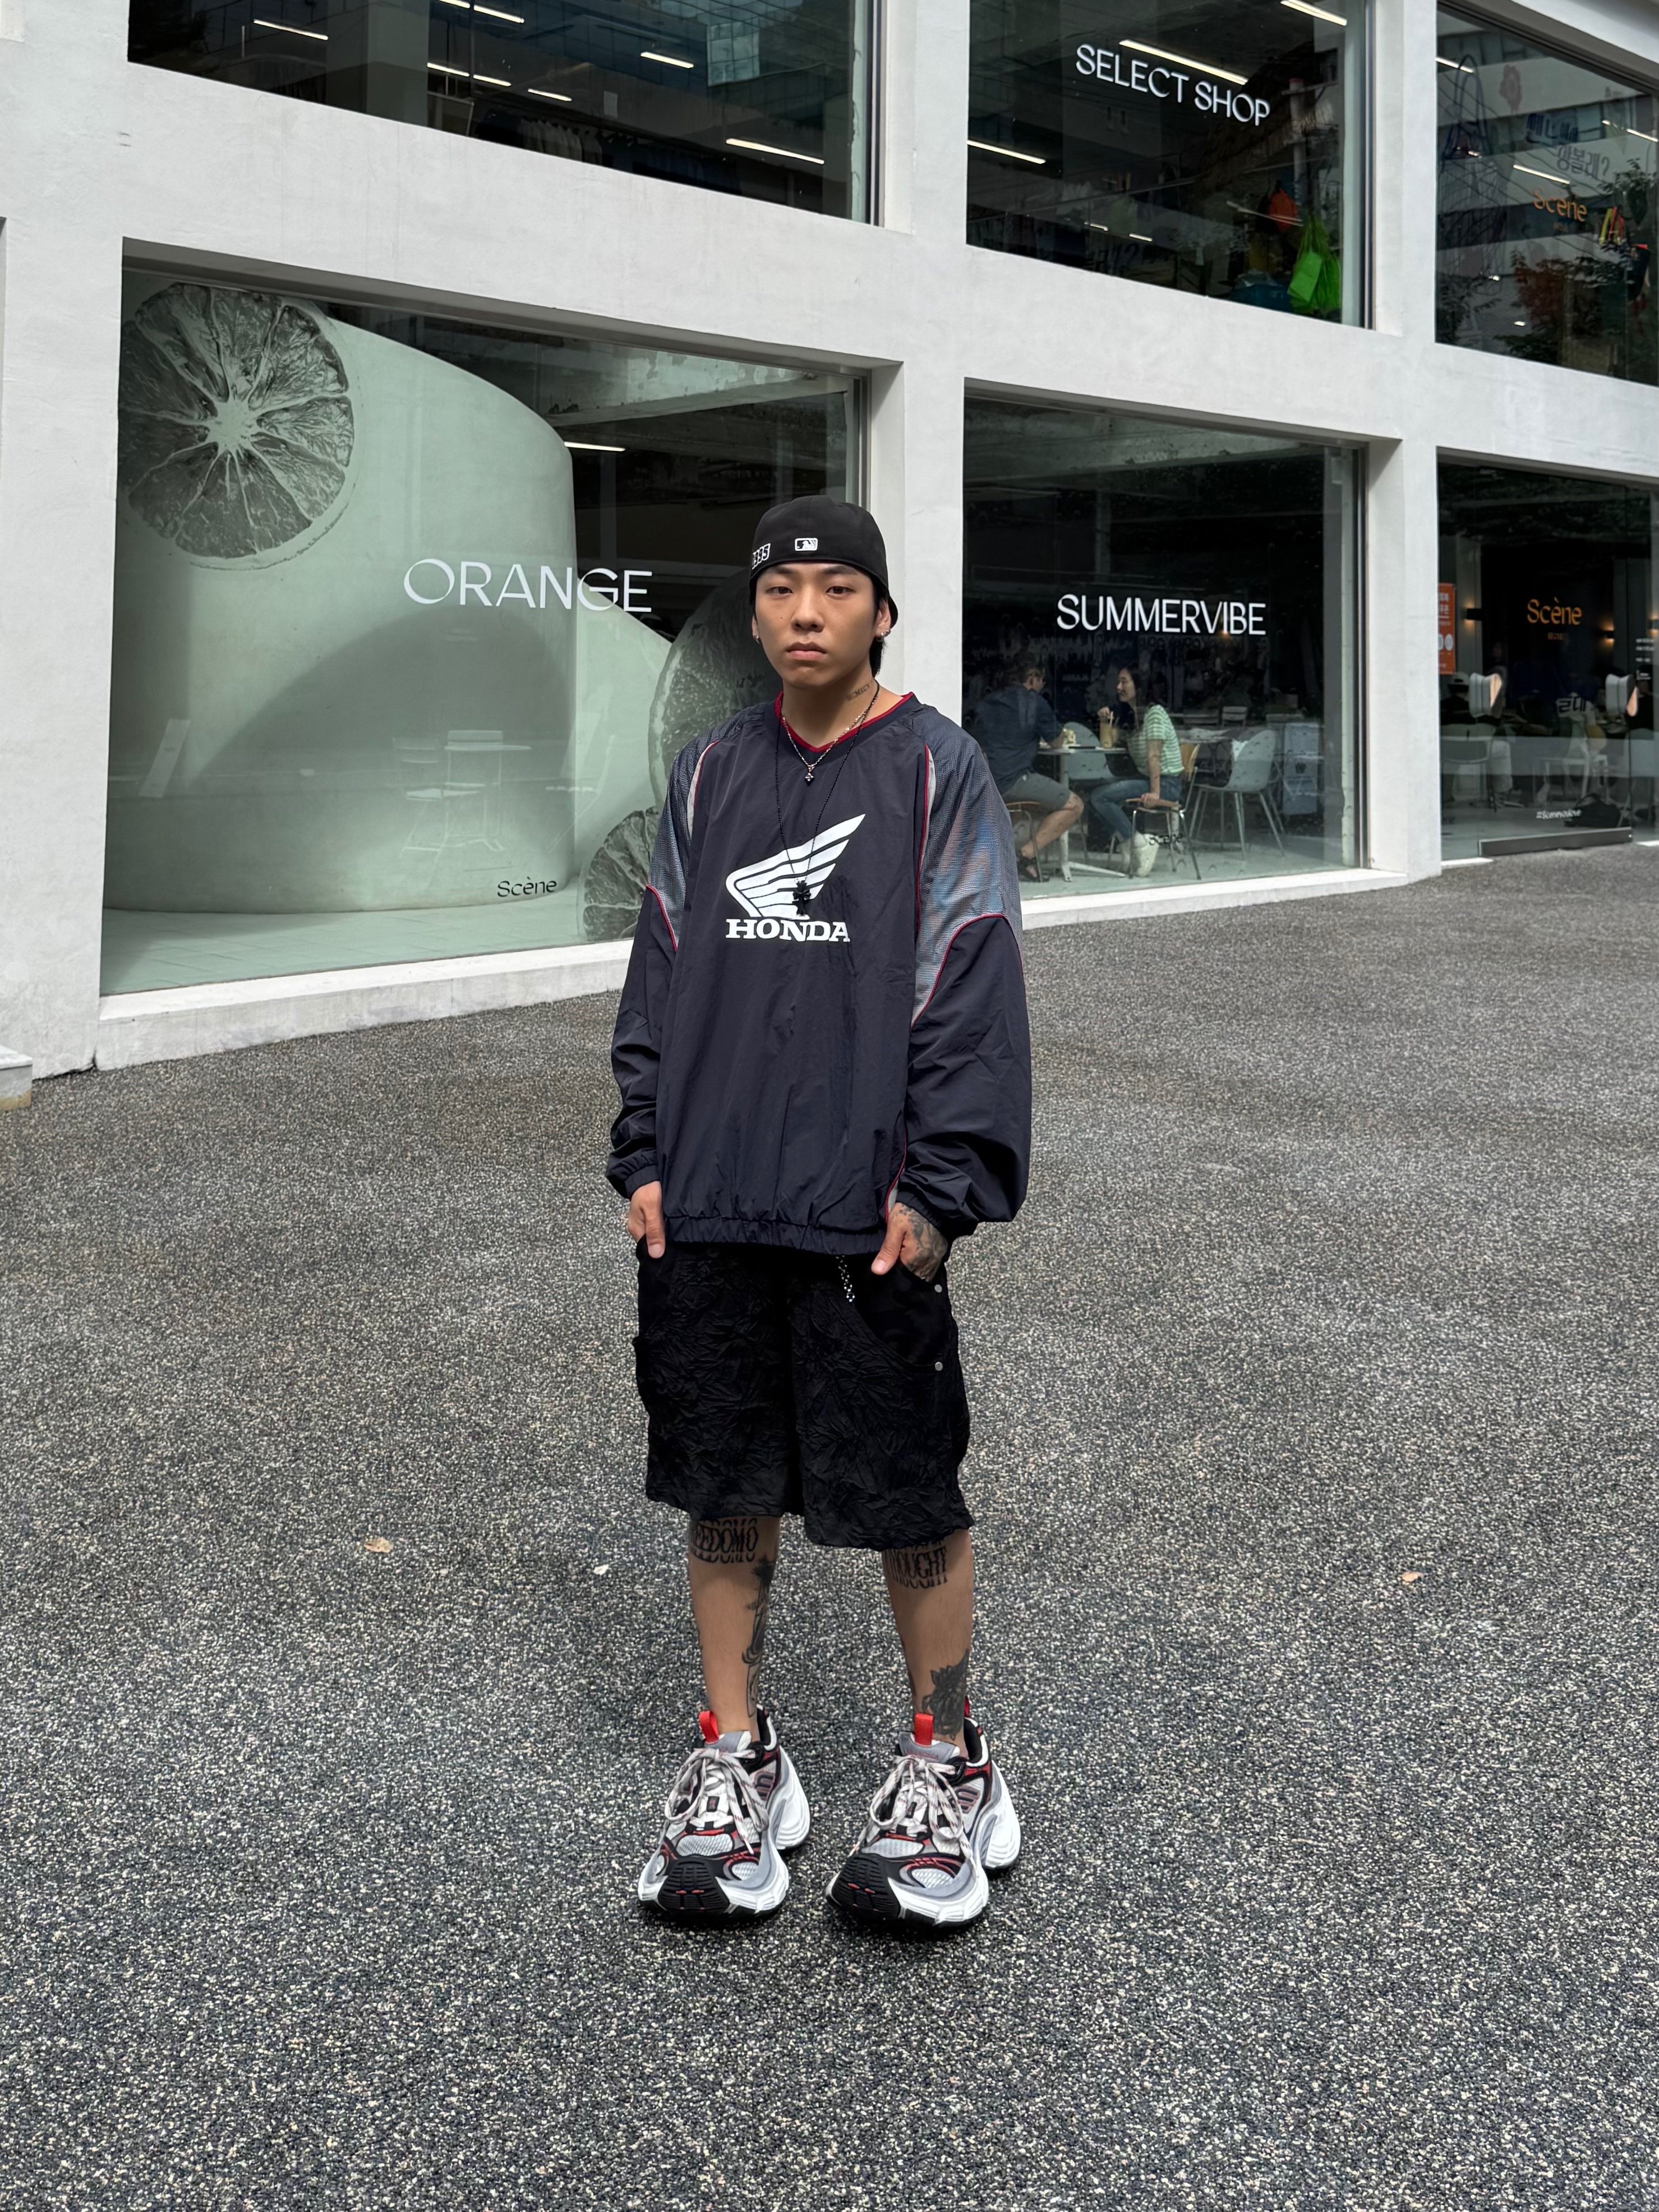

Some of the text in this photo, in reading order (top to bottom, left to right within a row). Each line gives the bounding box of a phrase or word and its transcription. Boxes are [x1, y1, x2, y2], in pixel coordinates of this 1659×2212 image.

[1076, 44, 1270, 126] SELECT SHOP
[404, 559, 653, 612] ORANGE
[1057, 594, 1266, 635] SUMMERVIBE
[1527, 597, 1582, 625] Scène
[497, 875, 557, 897] Scène
[726, 919, 850, 942] HONDA
